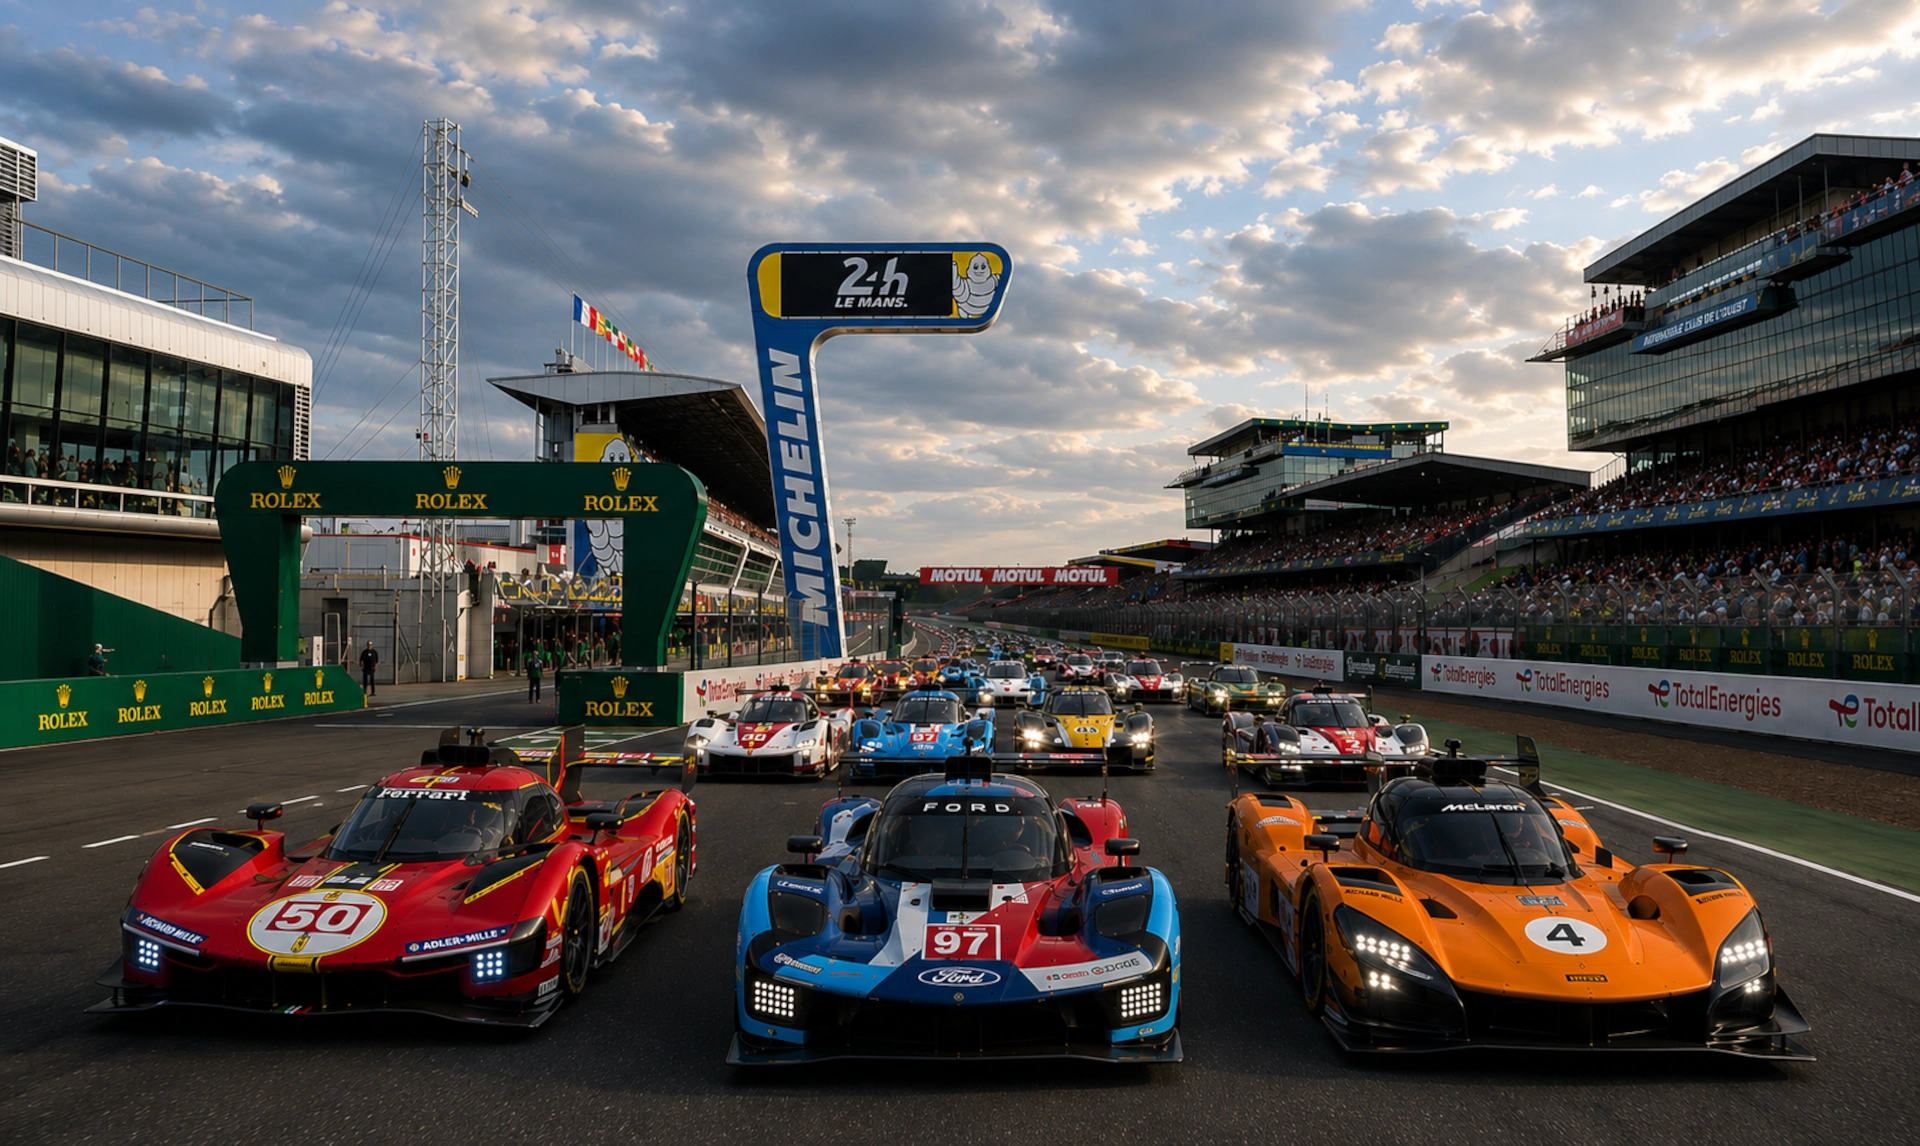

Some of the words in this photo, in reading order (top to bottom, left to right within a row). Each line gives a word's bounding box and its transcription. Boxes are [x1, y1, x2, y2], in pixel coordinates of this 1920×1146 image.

[834, 297, 855, 309] LE
[1704, 310, 1716, 325] DE
[768, 347, 830, 628] MICHELIN
[250, 492, 322, 509] ROLEX
[415, 493, 488, 510] ROLEX
[584, 494, 659, 512] ROLEX
[930, 568, 984, 583] MOTUL
[991, 569, 1045, 583] MOTUL
[1053, 569, 1107, 584] MOTUL
[1679, 648, 1712, 662] ROLEX
[1730, 649, 1762, 665] ROLEX
[1788, 652, 1825, 668] ROLEX
[1853, 654, 1895, 671] ROLEX
[1534, 669, 1610, 702] TotalEnergies
[251, 694, 285, 711] ROLEX
[304, 691, 334, 706] ROLEX
[1673, 682, 1782, 722] TotalEnergies
[118, 705, 161, 723] ROLEX
[190, 700, 227, 716] ROLEX
[585, 700, 654, 717] ROLEX
[38, 711, 88, 731] ROLEX
[923, 802, 1011, 813] FORD
[275, 903, 362, 933] 50
[934, 930, 989, 956] 97
[1546, 923, 1586, 947] 4
[932, 969, 985, 984] Ford
